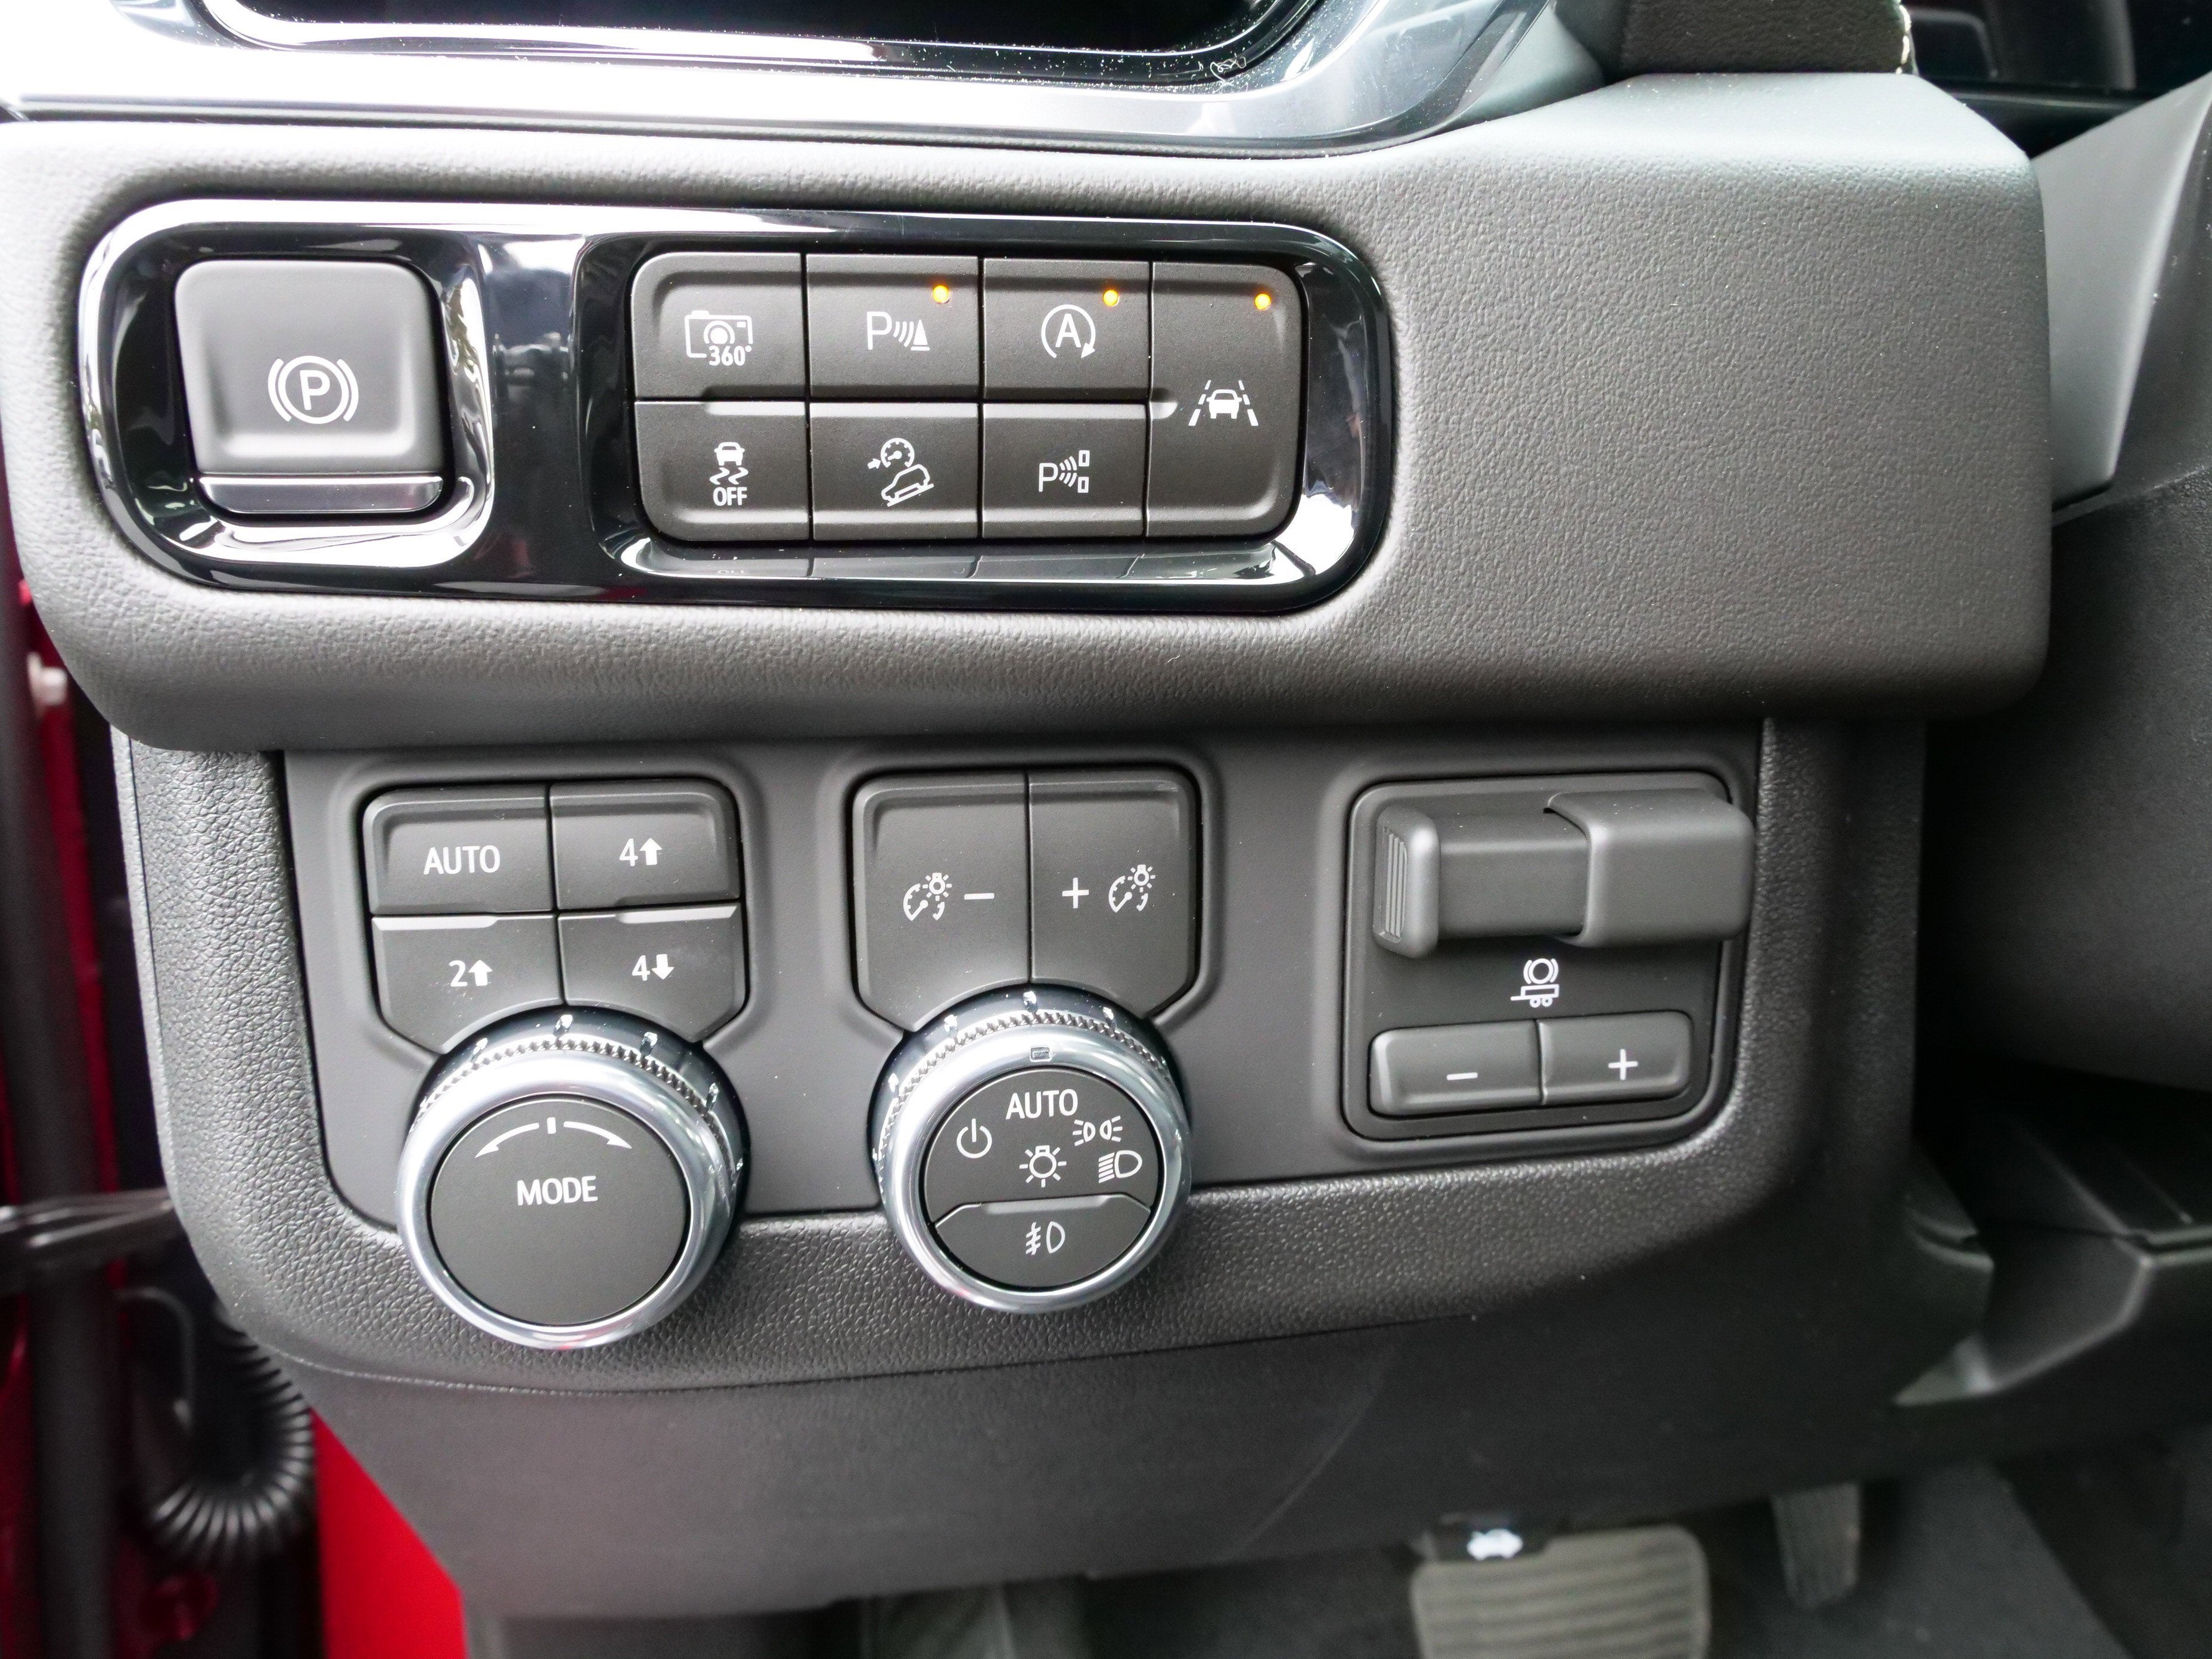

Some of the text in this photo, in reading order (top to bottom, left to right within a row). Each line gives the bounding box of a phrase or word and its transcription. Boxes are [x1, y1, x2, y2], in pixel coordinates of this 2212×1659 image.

[712, 485, 748, 507] OFF
[423, 844, 501, 875] AUTO
[1005, 1089, 1078, 1120] AUTO
[517, 1175, 598, 1206] MODE
